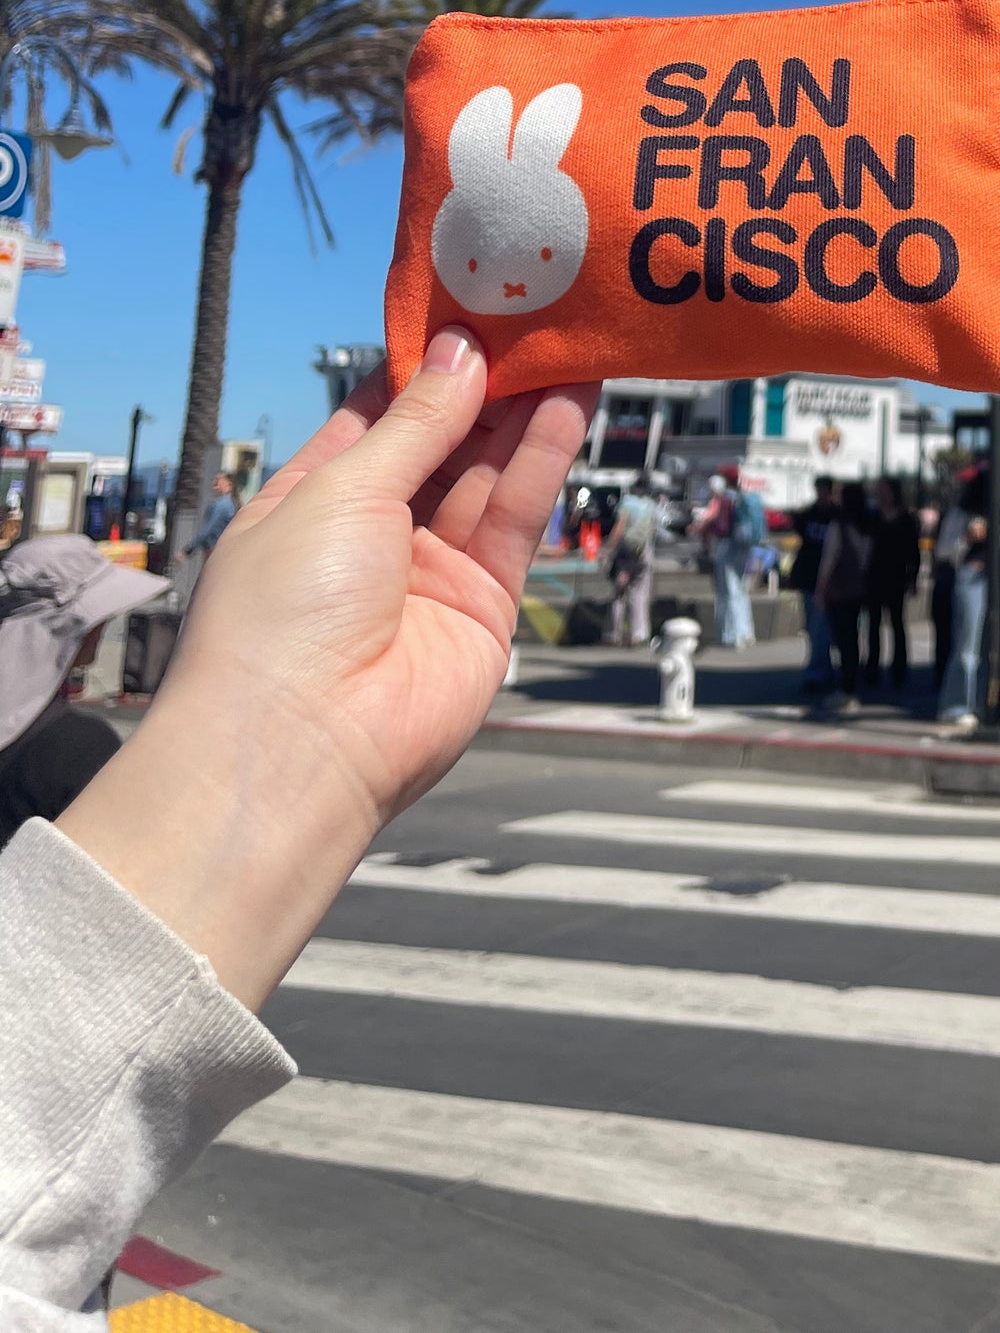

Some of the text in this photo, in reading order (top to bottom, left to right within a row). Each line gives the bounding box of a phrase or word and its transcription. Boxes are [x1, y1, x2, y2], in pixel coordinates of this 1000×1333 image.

[641, 57, 851, 128] SAN
[633, 134, 916, 211] FRAN
[629, 217, 960, 305] CISCO
